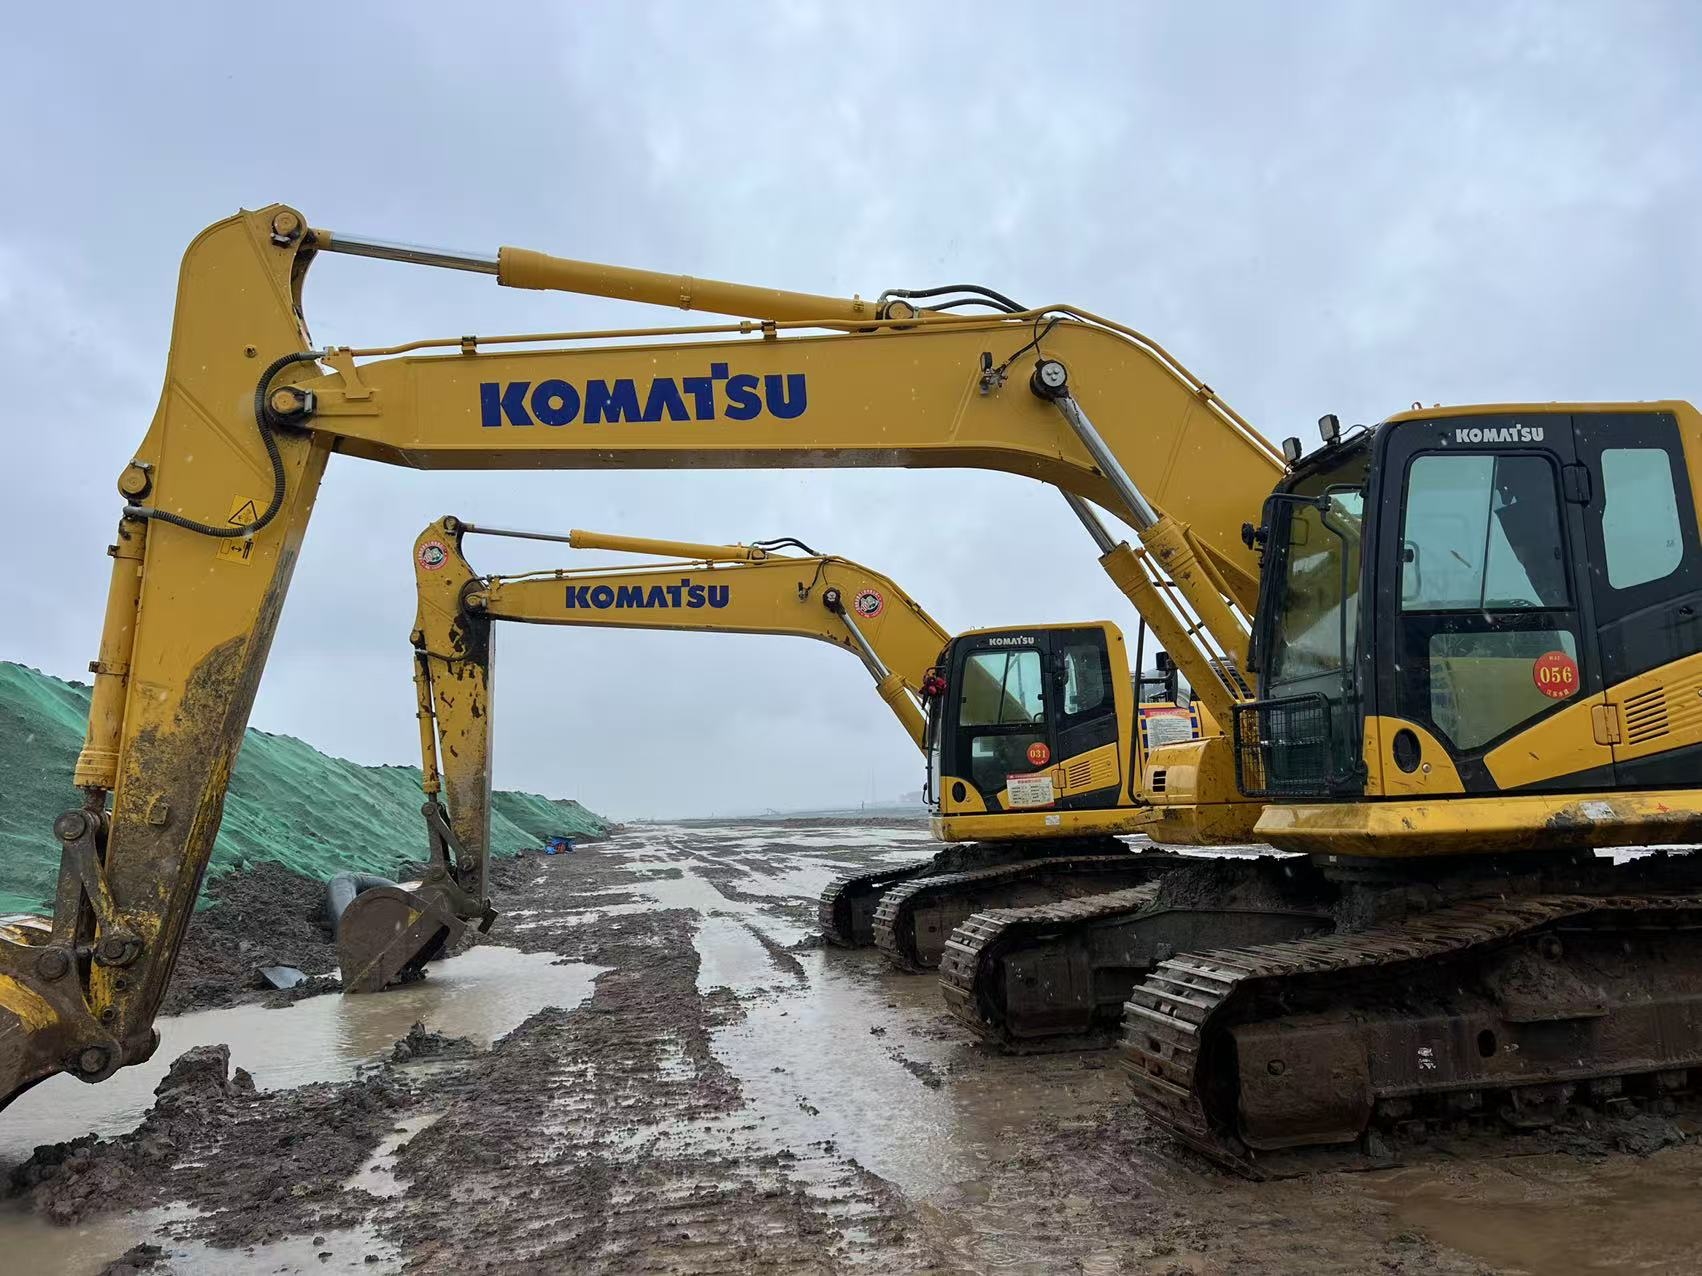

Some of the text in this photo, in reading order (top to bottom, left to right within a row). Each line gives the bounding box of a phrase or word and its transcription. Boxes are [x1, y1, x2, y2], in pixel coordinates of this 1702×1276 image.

[479, 362, 808, 428] KOMATSU
[1455, 423, 1544, 443] KOMATSU
[565, 578, 730, 609] KOMATSU
[989, 635, 1035, 646] KOMATSU
[1540, 666, 1573, 684] 056
[1029, 749, 1046, 759] 031
